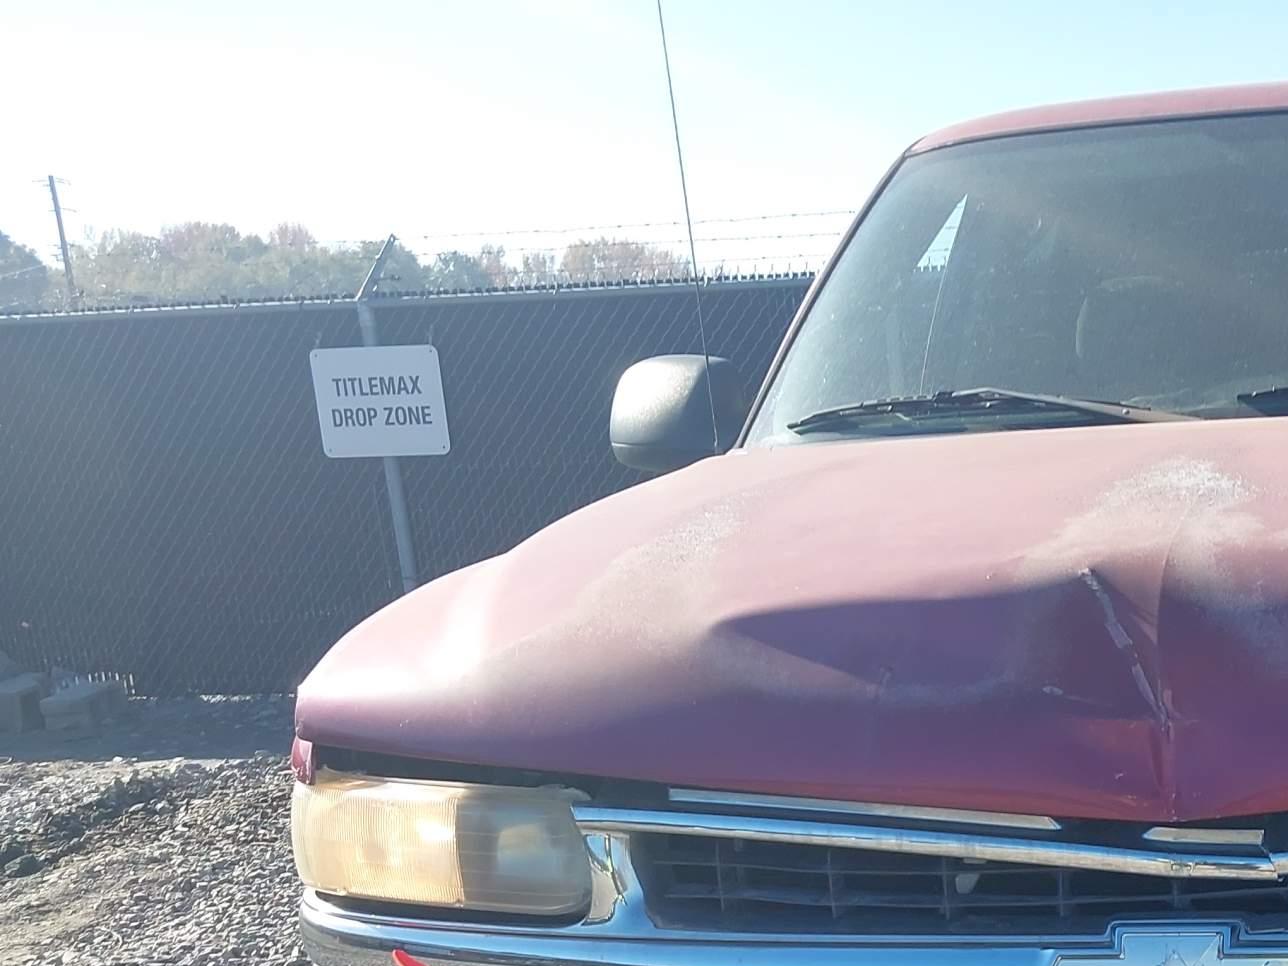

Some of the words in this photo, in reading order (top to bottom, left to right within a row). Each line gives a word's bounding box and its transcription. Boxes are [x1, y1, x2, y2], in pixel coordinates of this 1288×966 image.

[331, 375, 423, 398] TITLEMAX
[331, 407, 378, 428] DROP
[383, 405, 433, 426] ZONE
